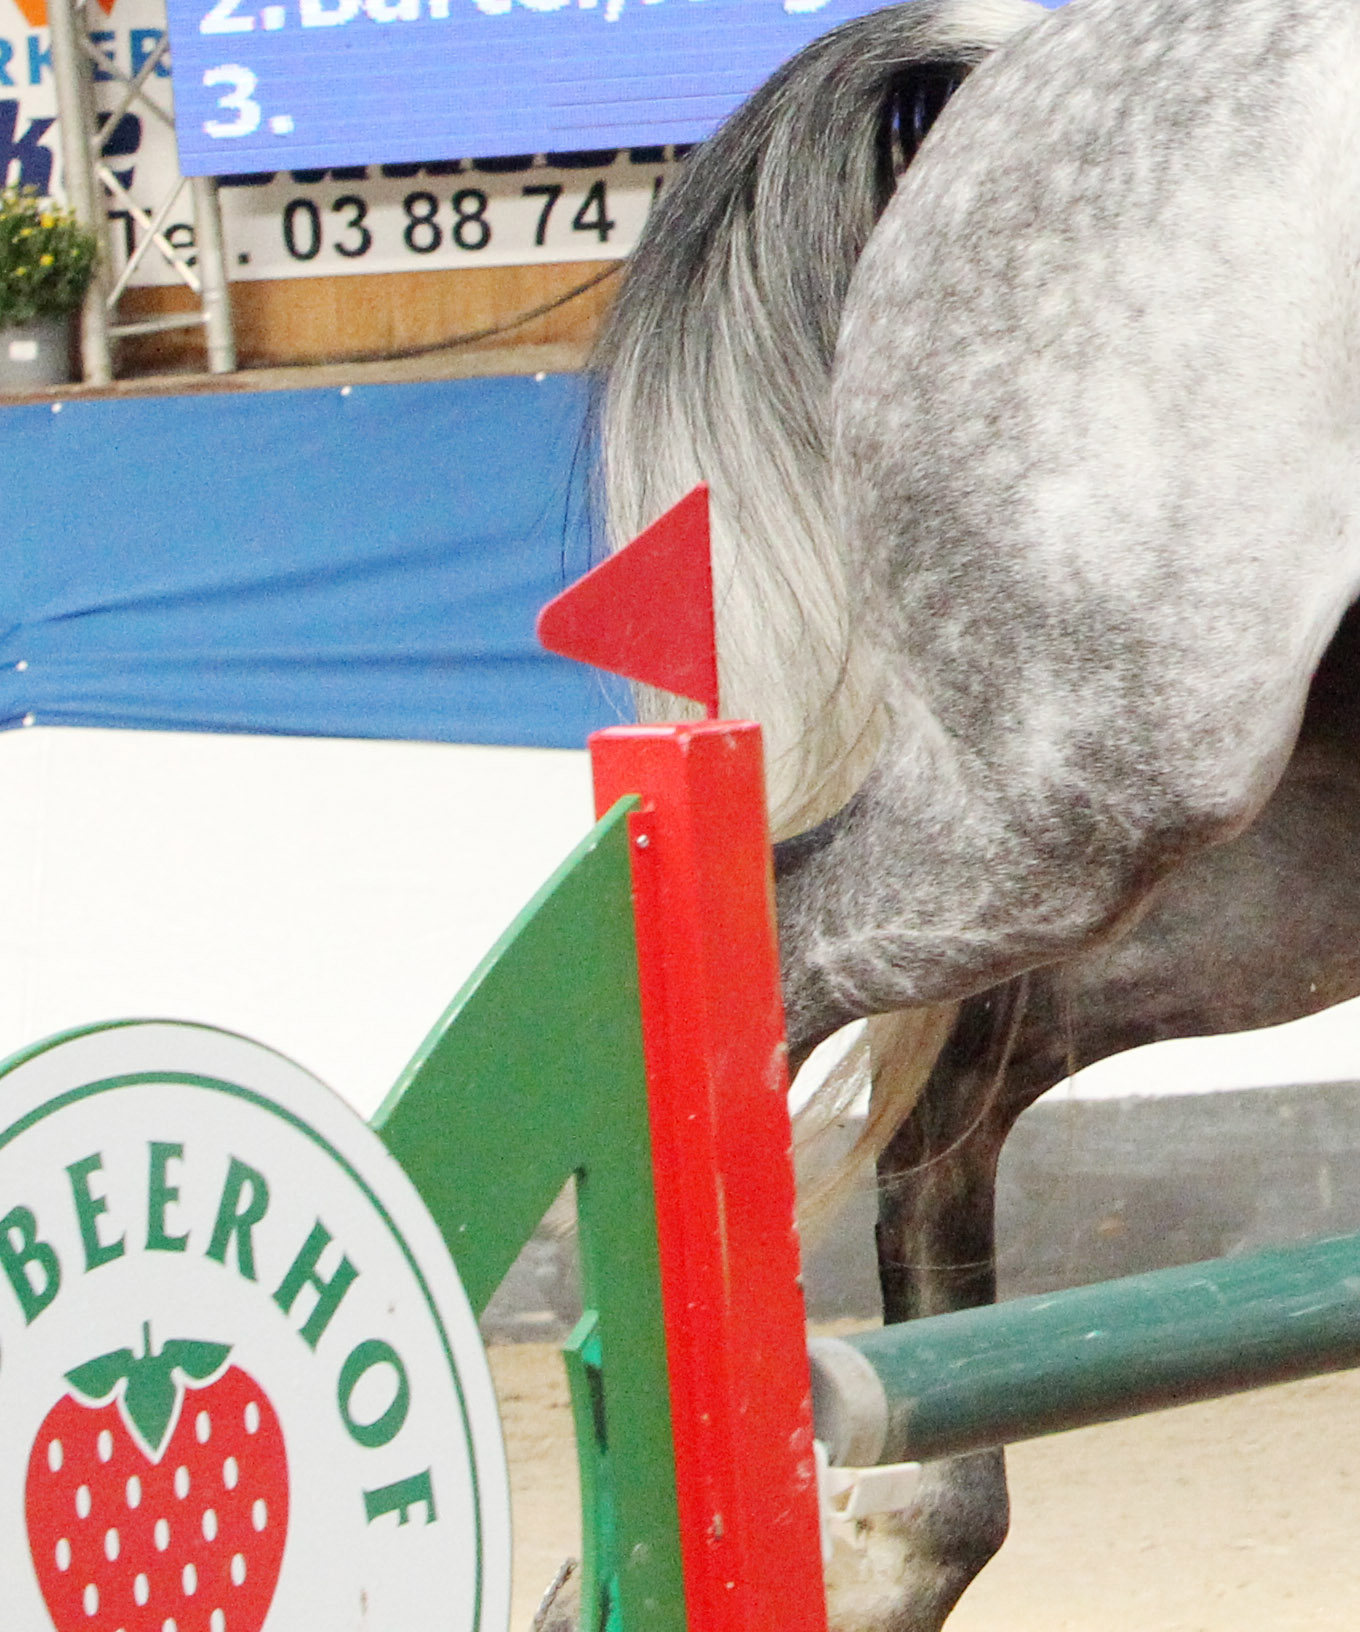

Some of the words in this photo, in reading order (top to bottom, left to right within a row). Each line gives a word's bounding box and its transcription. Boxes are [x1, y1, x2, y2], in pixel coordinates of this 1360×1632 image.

[202, 63, 294, 139] 3.
[107, 209, 250, 267] Te.
[283, 194, 373, 261] 03
[403, 187, 492, 254] 88
[521, 178, 615, 247] 74
